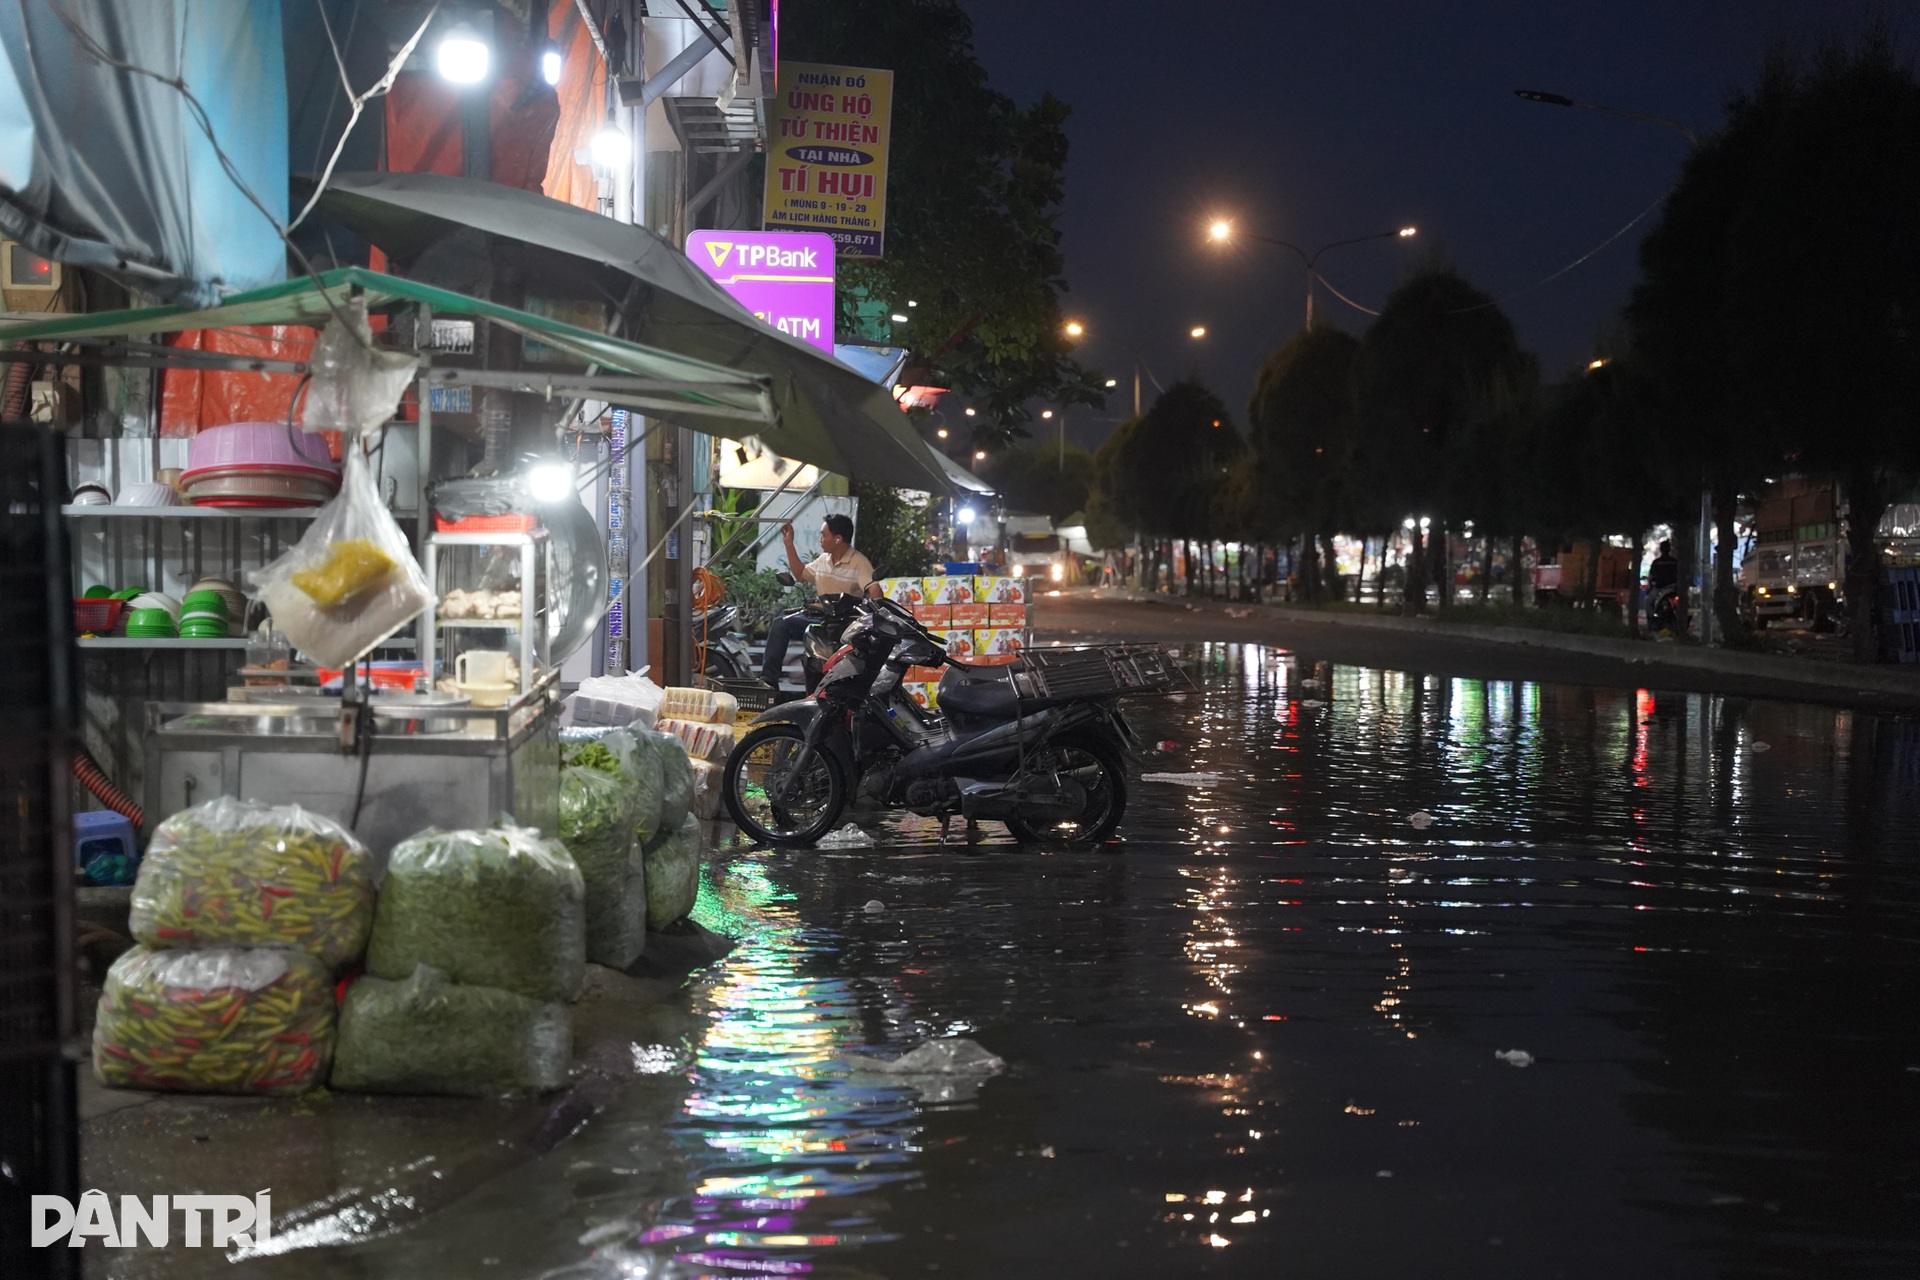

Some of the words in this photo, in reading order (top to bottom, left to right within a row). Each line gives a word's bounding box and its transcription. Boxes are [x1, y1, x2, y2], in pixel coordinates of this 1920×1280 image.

[798, 73, 840, 87] NHẬN
[788, 85, 834, 112] ỦNG
[842, 93, 872, 118] HỘ
[780, 116, 809, 138] TỪ
[814, 121, 878, 146] THIỆN
[798, 149, 823, 162] TẠI
[827, 151, 861, 164] NHÀ
[778, 165, 810, 192] TÍ
[818, 171, 873, 201] HỤI
[820, 201, 827, 209] 9
[836, 203, 847, 211] 19
[855, 204, 867, 213] 29
[772, 210, 787, 220] ÂM
[789, 213, 810, 223] LỊCH
[812, 214, 838, 225] HÀNG
[840, 216, 870, 226] THÁNG
[829, 232, 875, 246] 259.671
[735, 244, 818, 268] TPBank
[776, 317, 820, 339] ATM
